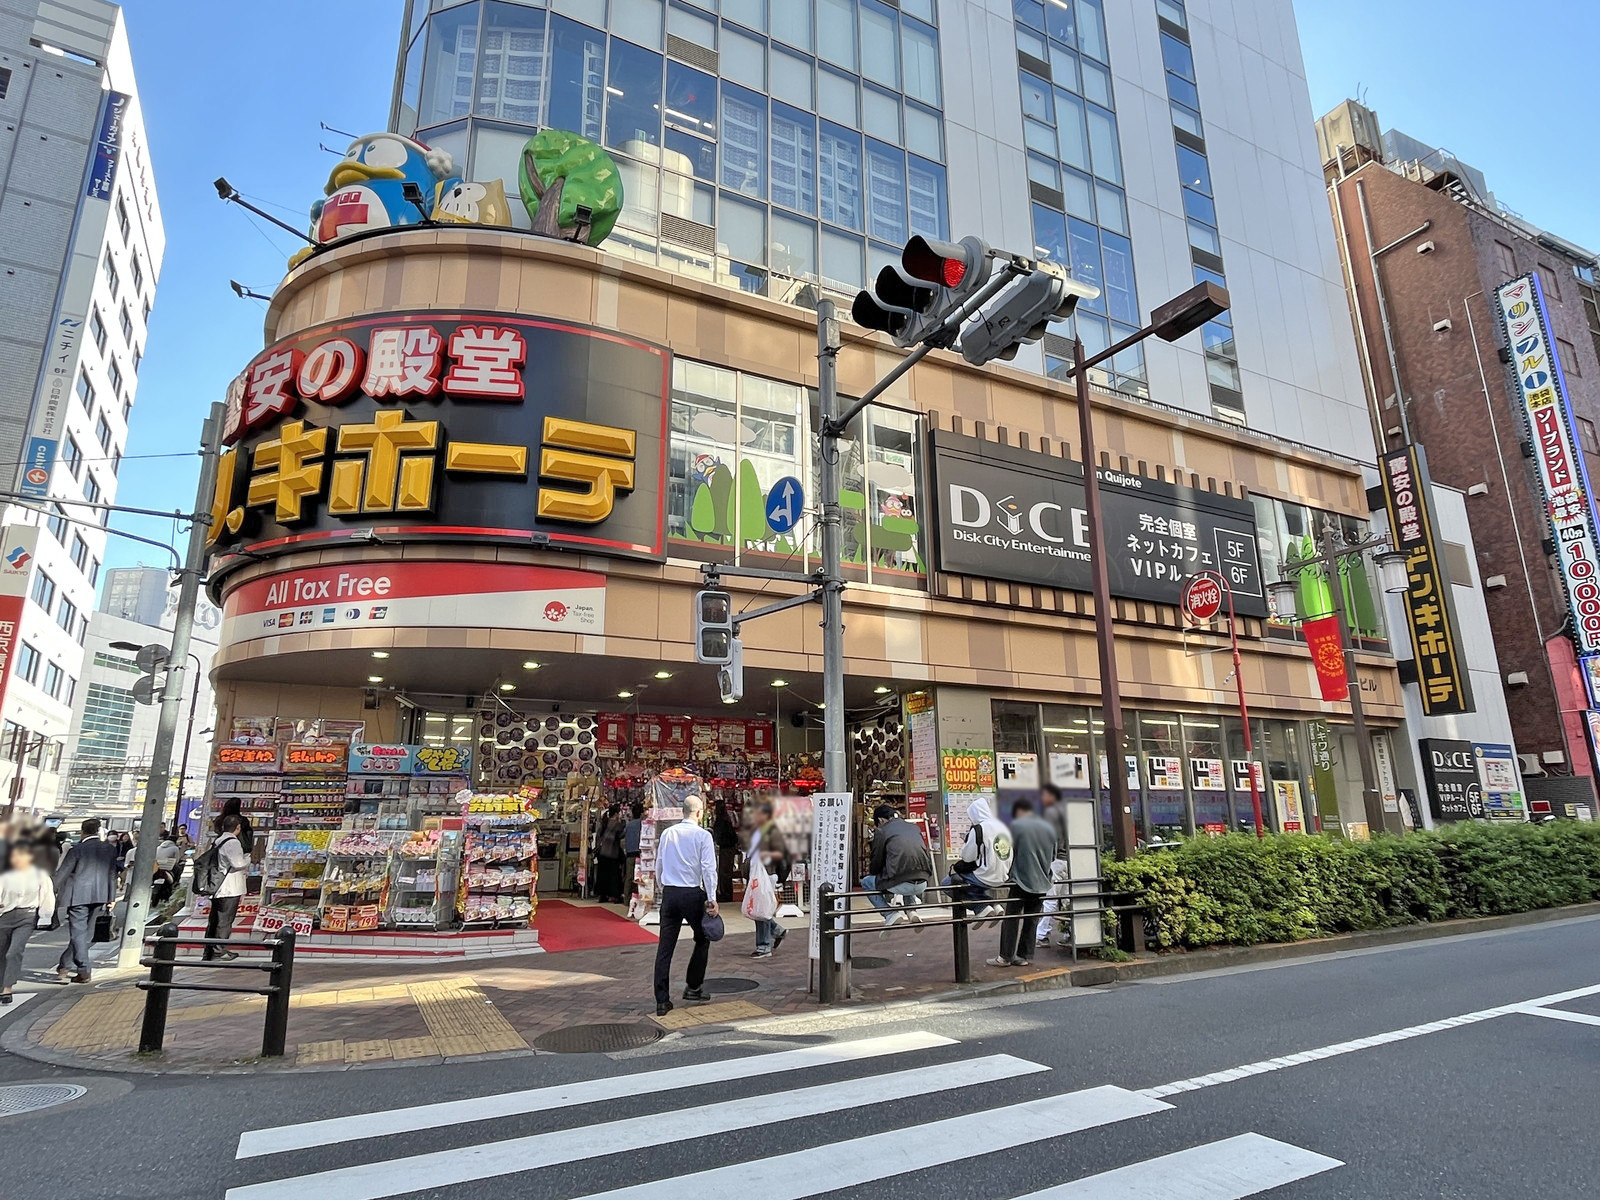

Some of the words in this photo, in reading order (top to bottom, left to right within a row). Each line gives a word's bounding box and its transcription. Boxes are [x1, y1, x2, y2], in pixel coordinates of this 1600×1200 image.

[1529, 389, 1551, 401] 池袋
[1537, 409, 1567, 484] ソープランド
[1105, 470, 1142, 488] Quijote
[1388, 456, 1421, 541] 驚安の殿堂
[1139, 513, 1197, 541] 完全個室
[953, 529, 982, 545] Disk
[984, 535, 1010, 550] City
[1011, 540, 1091, 562] Entertainme
[1127, 533, 1212, 565] ネットカフェ
[1228, 540, 1244, 558] 5F
[1231, 566, 1248, 584] 6F
[265, 580, 290, 606] All
[294, 578, 331, 601] Tax
[336, 573, 391, 597] Free
[1190, 588, 1218, 609] 消火栓
[263, 618, 276, 628] VISA
[1316, 722, 1330, 771] トキワ通り
[944, 757, 977, 769] FLOOR
[946, 770, 977, 782] GUIDE
[819, 798, 843, 807] お願い
[1469, 791, 1480, 803] 5F
[1471, 804, 1482, 815] 6F
[331, 918, 345, 928] 198
[361, 917, 377, 927] 198
